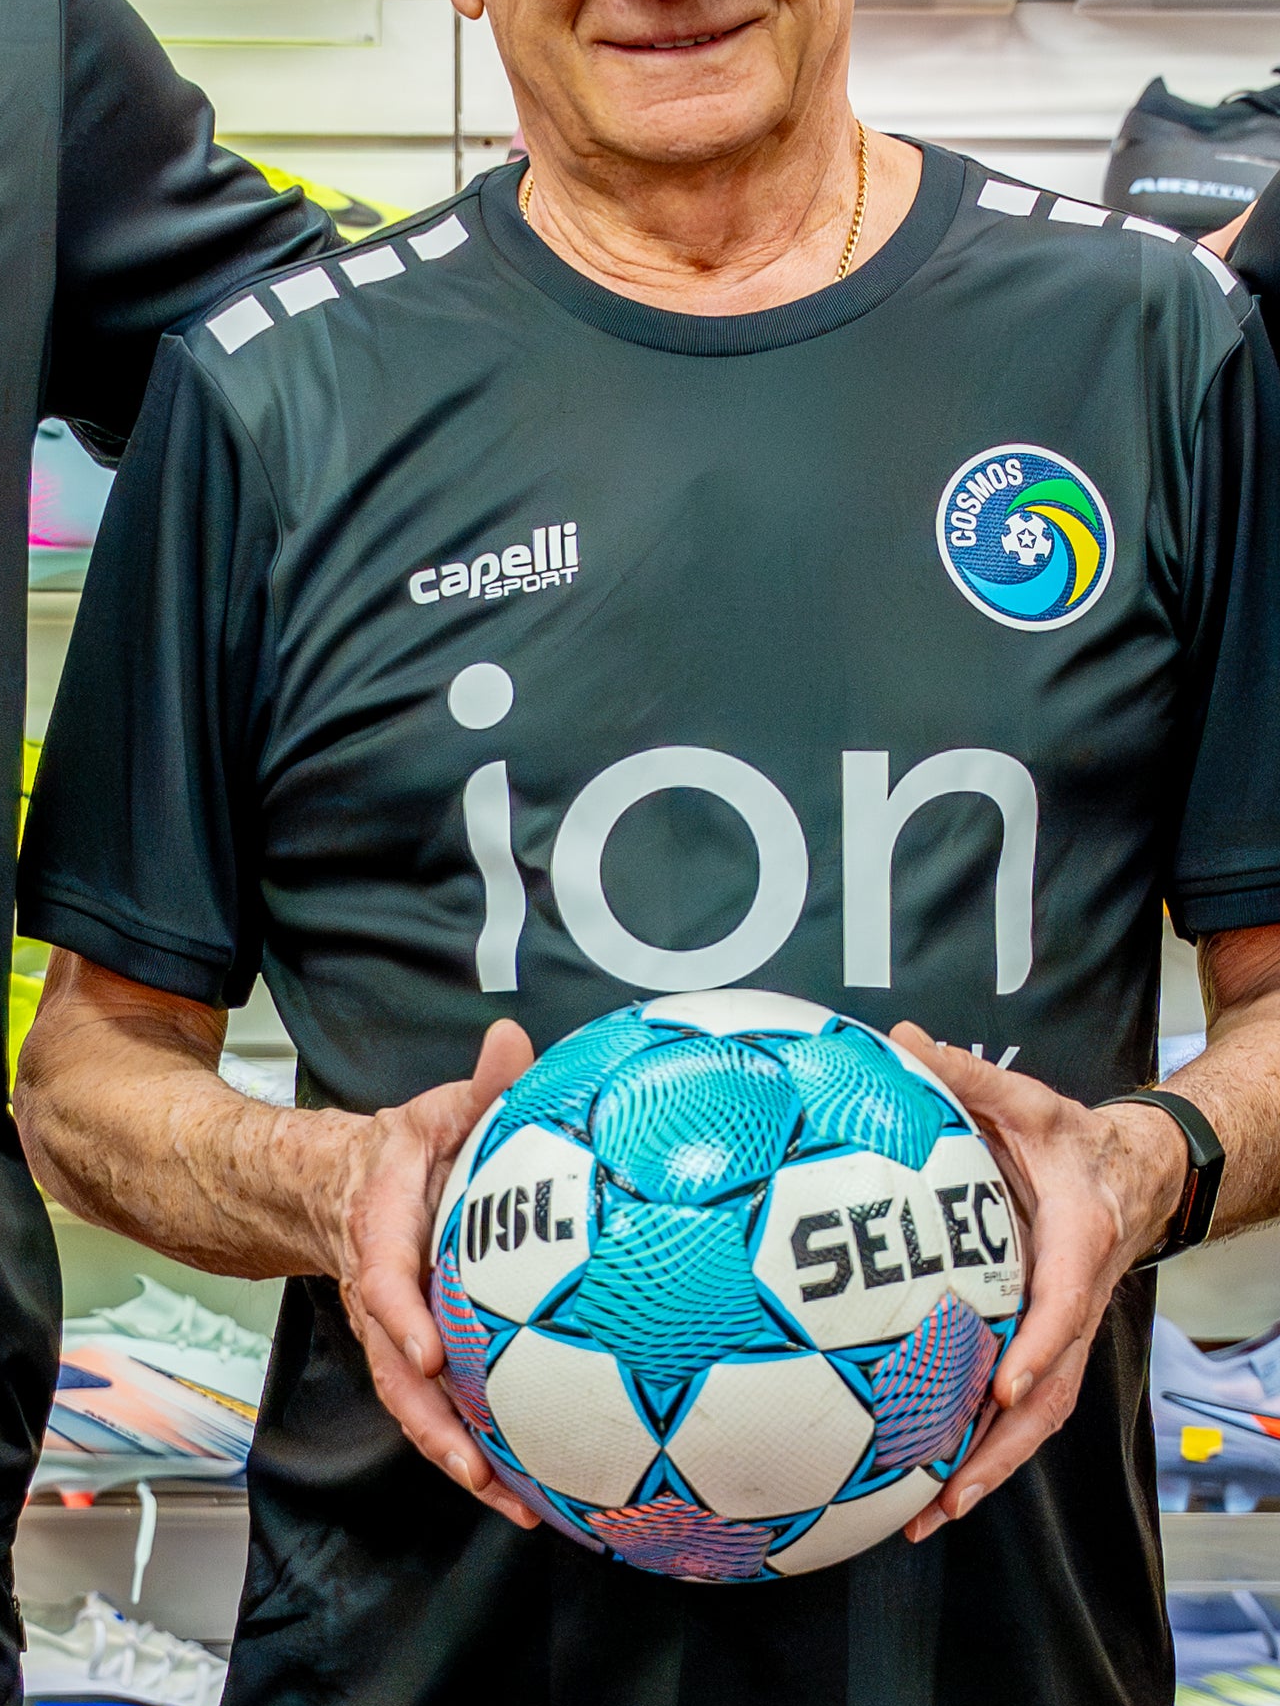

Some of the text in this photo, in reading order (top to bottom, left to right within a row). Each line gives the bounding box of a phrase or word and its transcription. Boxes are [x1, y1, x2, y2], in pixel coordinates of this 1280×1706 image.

[951, 457, 1024, 548] COSMOS
[408, 522, 580, 606] capelli
[484, 566, 579, 601] SPORT
[447, 662, 1040, 996] ion
[467, 1178, 575, 1263] USL
